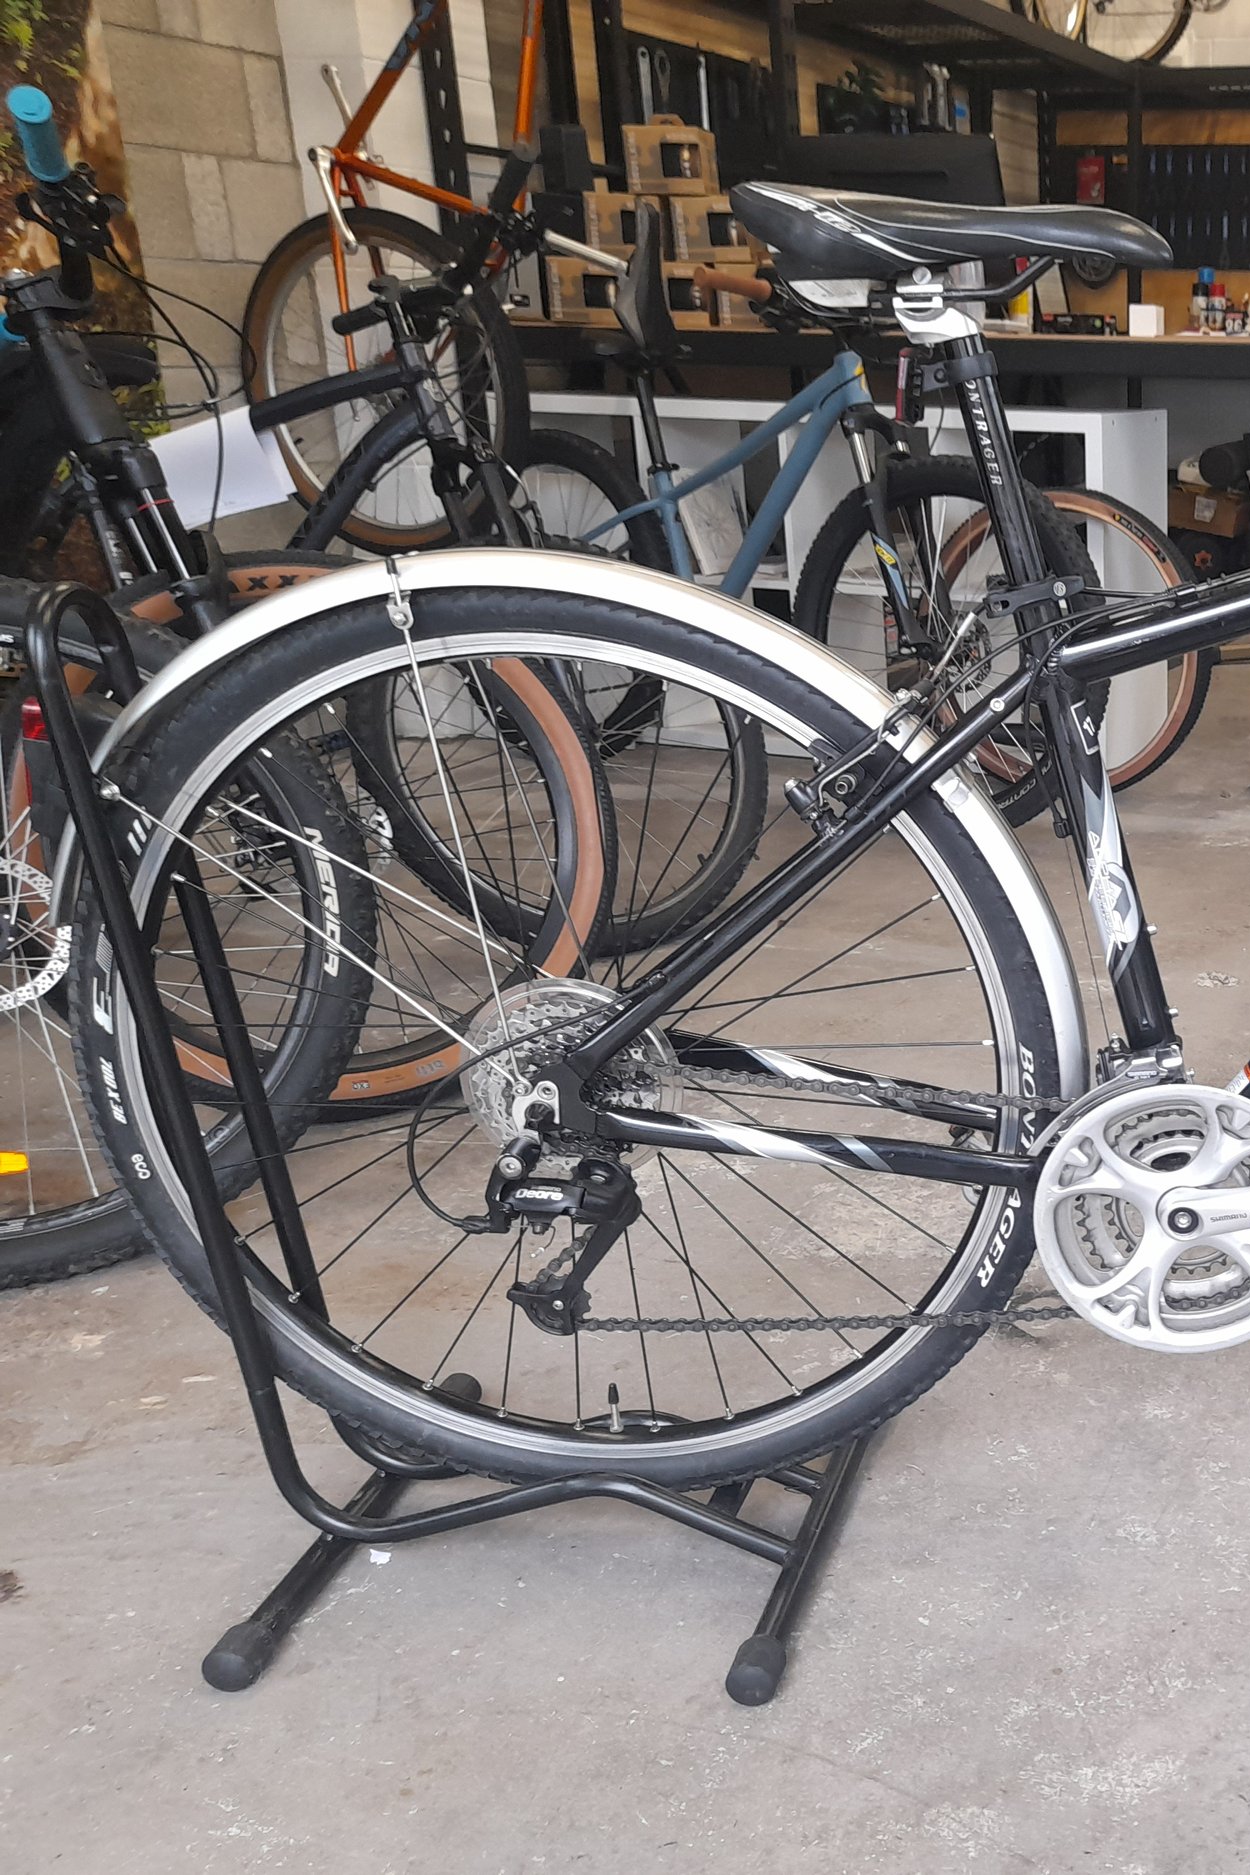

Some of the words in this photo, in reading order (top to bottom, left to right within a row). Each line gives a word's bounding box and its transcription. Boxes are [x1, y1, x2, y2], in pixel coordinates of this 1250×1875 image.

[964, 379, 1003, 485] ONTRAGER
[303, 826, 341, 978] MERIDA
[99, 1056, 119, 1090] 700
[515, 1188, 564, 1201] Deore
[977, 1041, 1037, 1288] BONTAGER
[1209, 1213, 1248, 1223] SHIMANO
